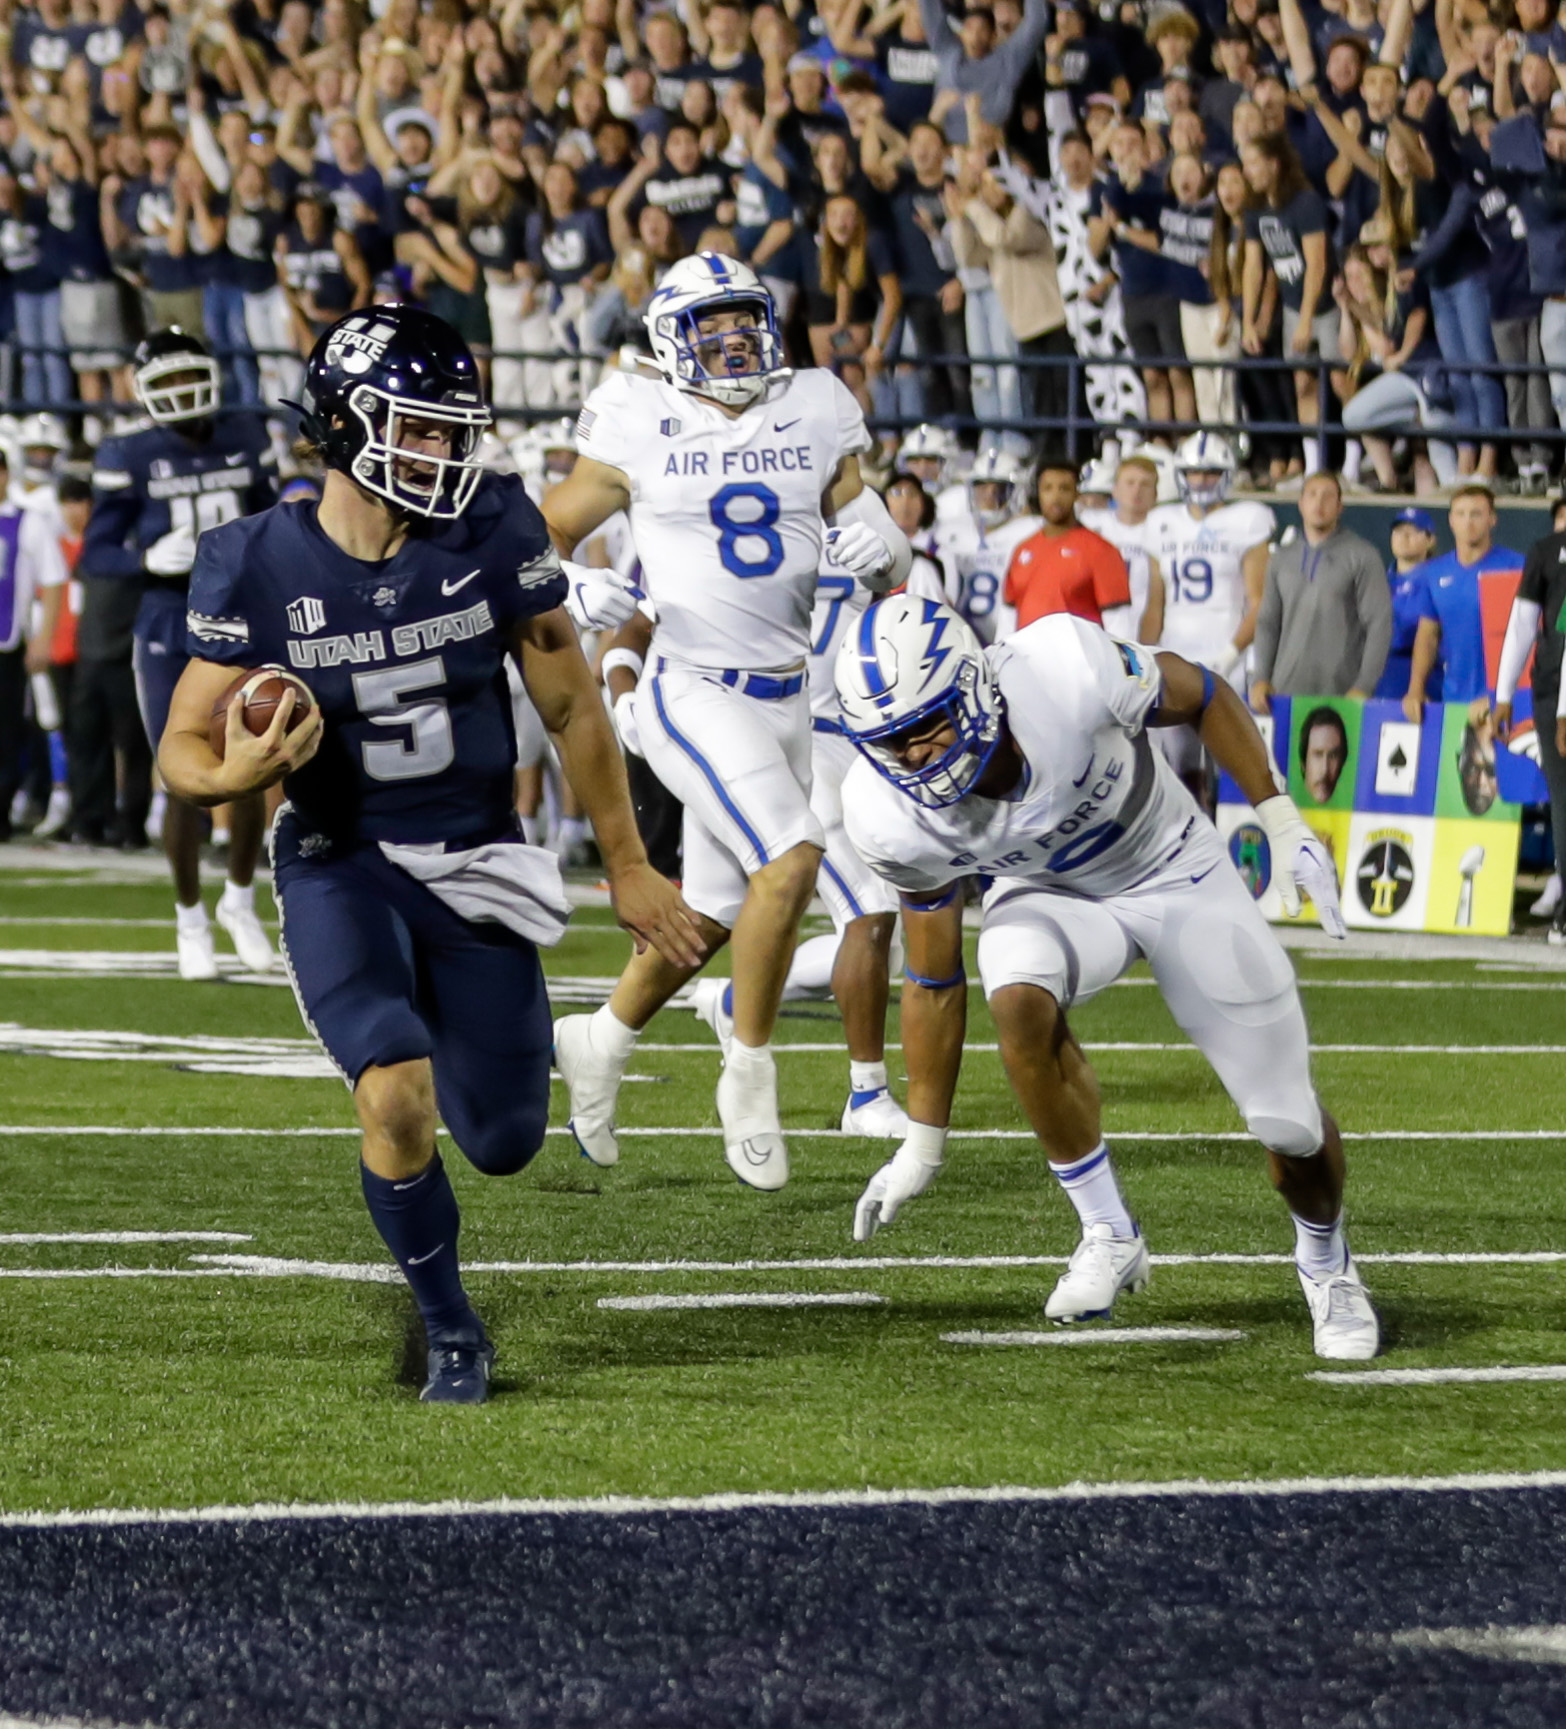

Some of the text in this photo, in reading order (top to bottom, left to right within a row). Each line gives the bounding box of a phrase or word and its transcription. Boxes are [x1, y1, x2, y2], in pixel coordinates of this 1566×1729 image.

[328, 329, 388, 362] STATE
[664, 446, 813, 477] AIR FORCE
[708, 481, 786, 579] 8
[1171, 557, 1214, 603] 19
[286, 600, 495, 668] UTAH STATE
[351, 655, 455, 782] 5
[977, 757, 1125, 873] AIR FORCE
